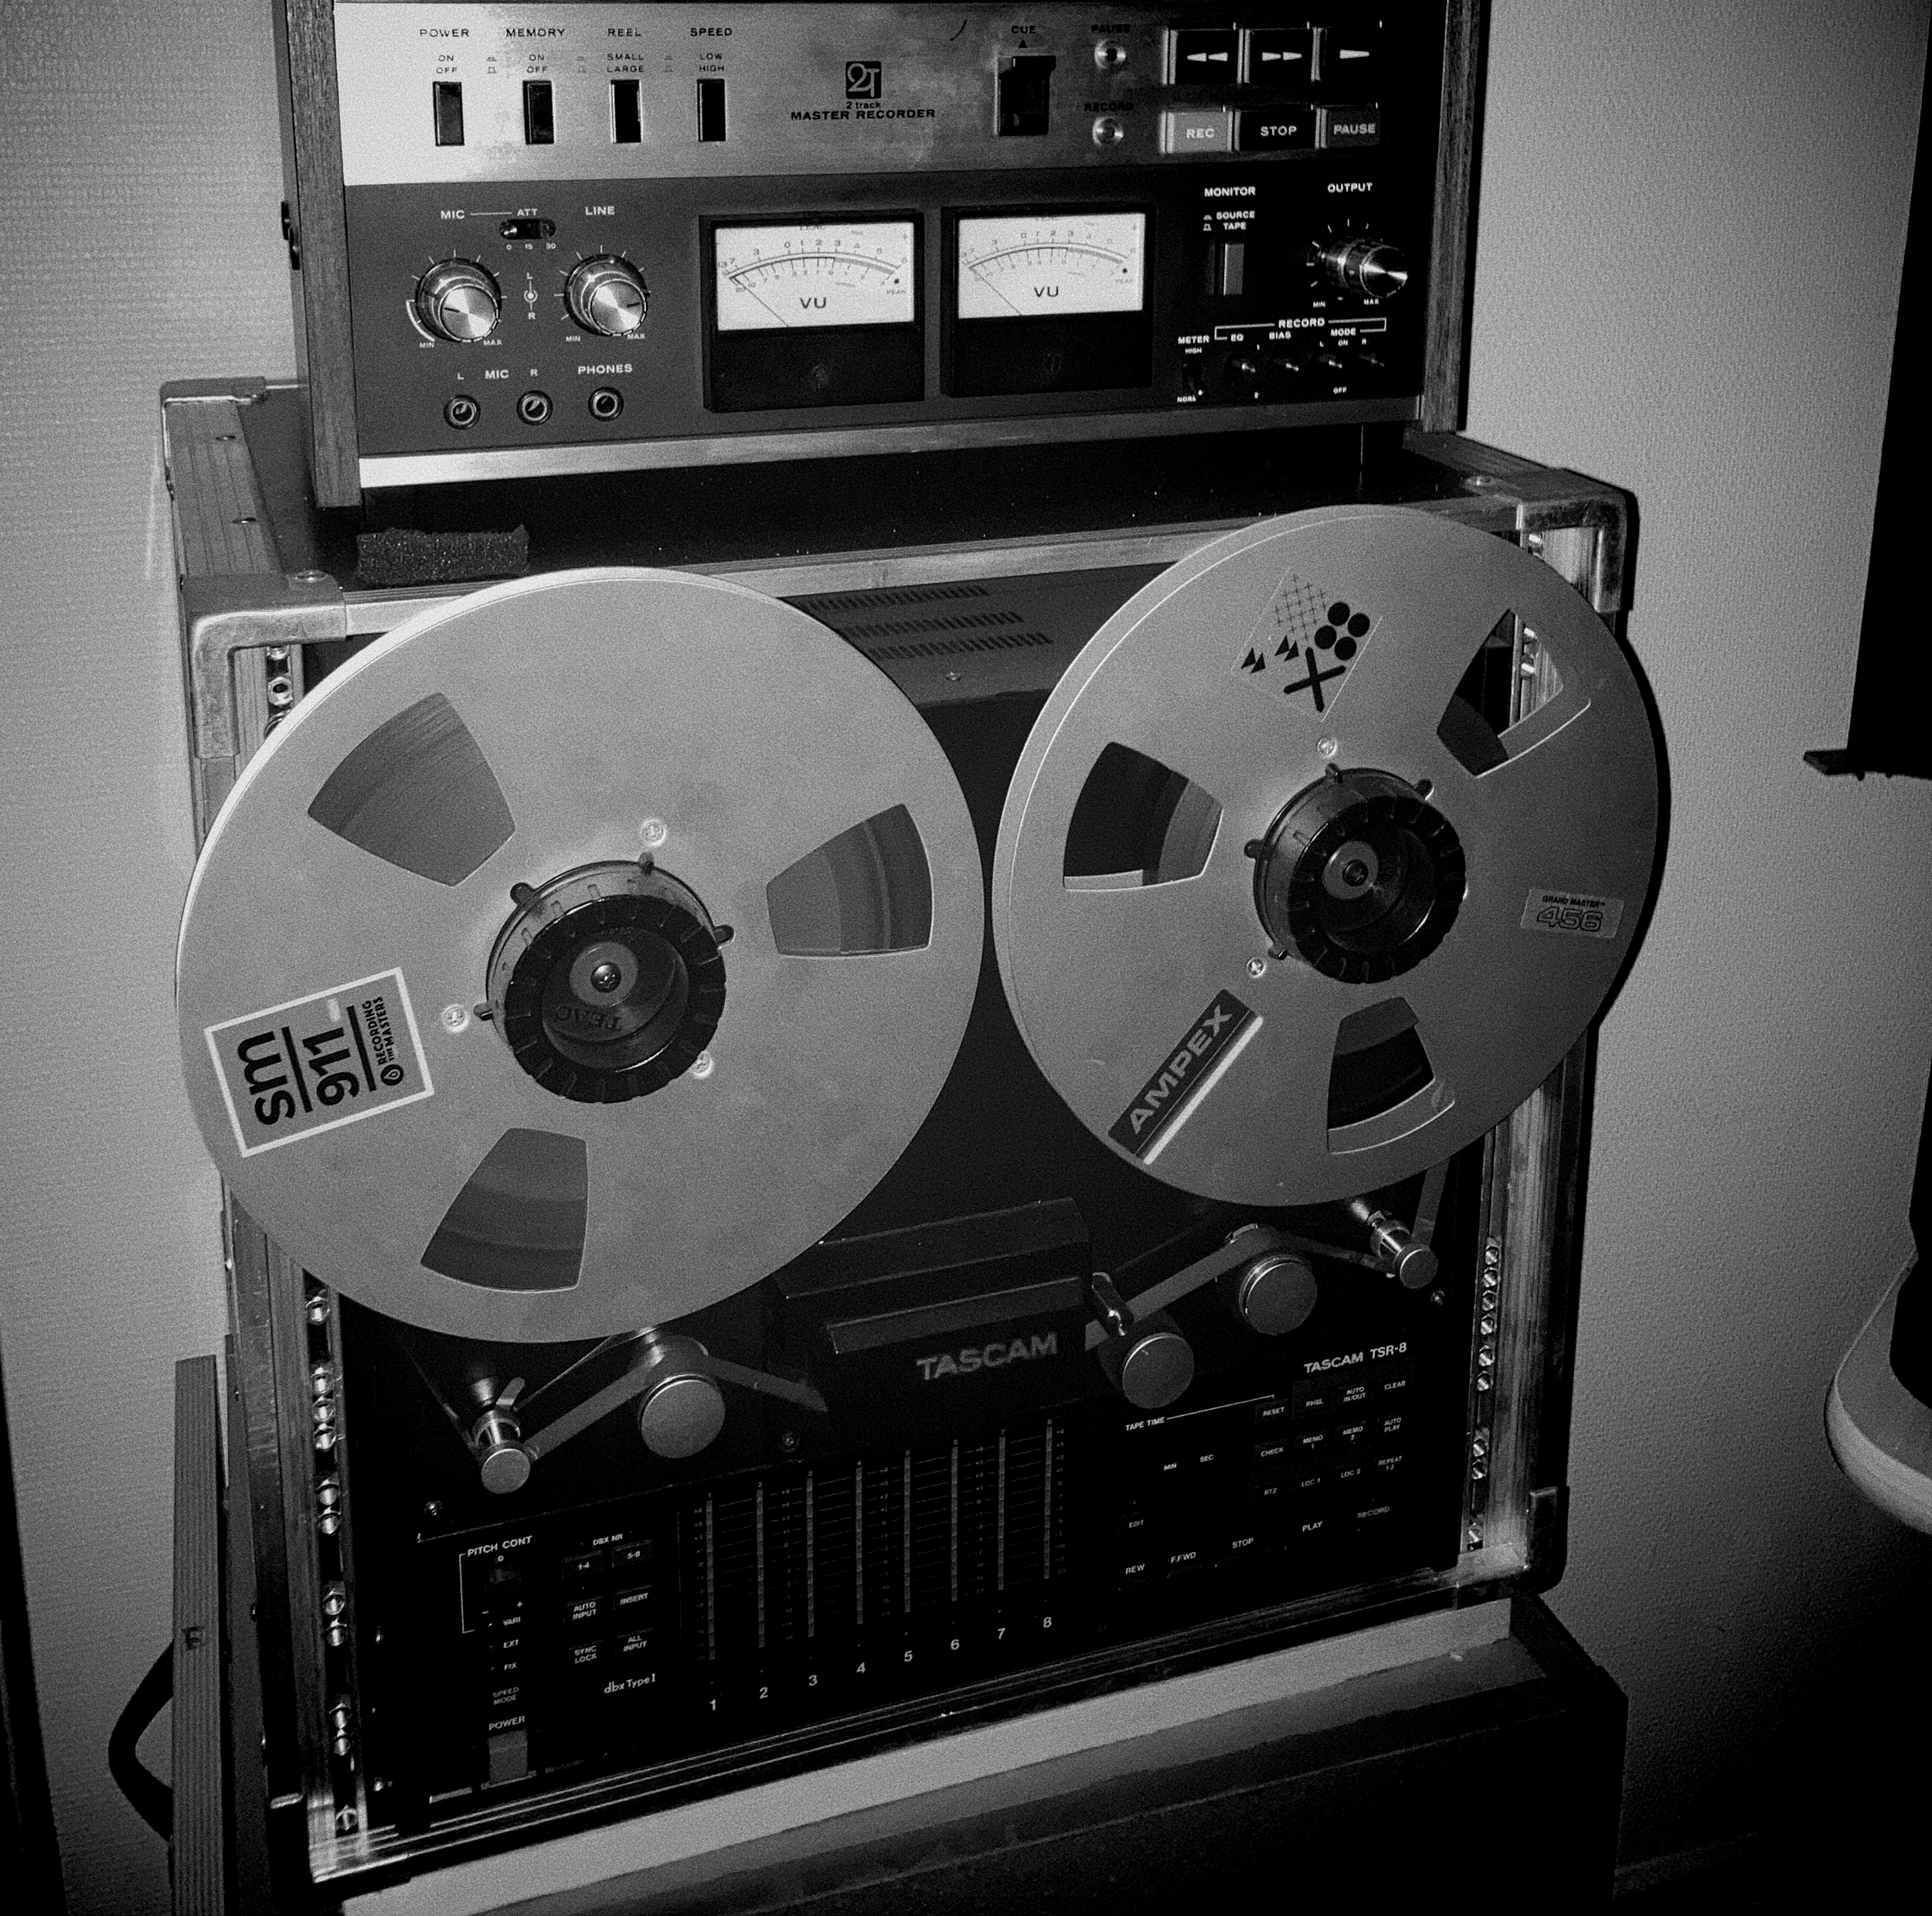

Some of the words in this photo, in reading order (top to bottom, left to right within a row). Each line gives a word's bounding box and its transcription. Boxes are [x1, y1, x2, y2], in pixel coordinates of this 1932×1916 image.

[420, 29, 469, 37] POWER
[505, 28, 565, 37] MEMORY
[607, 28, 641, 37] REEL
[690, 27, 733, 36] SPEED
[1011, 26, 1036, 34] CUE
[1091, 24, 1131, 33] PAUSE
[855, 100, 881, 109] track
[1084, 103, 1134, 112] RECORD
[791, 111, 849, 121] MASTER
[856, 109, 935, 119] RECORDER
[1185, 128, 1215, 138] REC
[1260, 126, 1297, 137] STOP
[1333, 123, 1376, 134] PAUSE
[1204, 186, 1256, 197] MONITOR
[1328, 182, 1372, 192] OUTPUT
[440, 210, 465, 220] MIC
[517, 209, 538, 217] ATT
[585, 206, 615, 216] LINE
[1216, 211, 1256, 220] SOURCE
[1223, 222, 1247, 230] TAPE
[1034, 286, 1059, 297] VU
[800, 298, 826, 308] VU
[1278, 318, 1325, 328] RECORD
[1230, 333, 1244, 342] EQ
[1331, 328, 1356, 336] MODE
[1178, 335, 1209, 345] METER
[485, 369, 509, 379] MIC
[578, 364, 633, 375] PHONES
[1543, 895, 1567, 904] GRAND
[1536, 906, 1604, 932] 456
[373, 996, 394, 1046] MASTERS
[362, 1000, 387, 1066] RECORDING
[302, 1027, 360, 1106] 911
[1130, 1005, 1233, 1135] AMPEX
[917, 1332, 1058, 1380] TASCAM
[1304, 1352, 1364, 1373] TASCAM
[1369, 1342, 1407, 1360] TSR-8
[1384, 1380, 1406, 1390] CLEAR
[1346, 1387, 1365, 1395] AUTO
[1263, 1407, 1285, 1417] RESET
[1125, 1421, 1145, 1431] TAPE
[1147, 1417, 1165, 1427] TIME
[1383, 1417, 1402, 1427] AUTO
[1342, 1426, 1363, 1435] MEMO
[1383, 1424, 1401, 1433] PLAY
[1303, 1434, 1324, 1445] MEMO
[1260, 1447, 1284, 1458] CHECK
[1163, 1462, 1177, 1471] MIN
[1378, 1455, 1403, 1467] REPEAT
[1341, 1470, 1355, 1479] LOC
[1301, 1479, 1315, 1488] LOC
[1357, 1506, 1390, 1520] RECORD
[1128, 1519, 1145, 1529] EDIT
[1302, 1520, 1323, 1533] PLAY
[467, 1543, 498, 1557] PITCH
[502, 1535, 532, 1550] CONT
[592, 1537, 609, 1547] DBX
[1232, 1537, 1253, 1549] STOP
[1125, 1563, 1145, 1575] REW
[620, 1592, 649, 1605] INSERT
[573, 1601, 596, 1612] AUTO
[572, 1608, 597, 1621] INPUT
[503, 1616, 521, 1627] VARI
[1043, 1616, 1053, 1629] 8
[997, 1627, 1006, 1639] 7
[503, 1639, 519, 1649] EXT
[628, 1635, 642, 1644] ALL
[951, 1639, 960, 1651] 6
[574, 1645, 597, 1656] SYNC
[623, 1641, 648, 1652] INPUT
[574, 1652, 597, 1665] LOCK
[903, 1649, 913, 1662] 5
[856, 1662, 866, 1675] 4
[604, 1681, 625, 1695] dbx
[626, 1676, 650, 1690] Type
[808, 1674, 818, 1687] 3
[492, 1686, 519, 1698] SPEED
[760, 1686, 769, 1700] 2
[493, 1694, 517, 1706] MODE
[709, 1699, 717, 1711] 1
[488, 1715, 526, 1731] POWER
